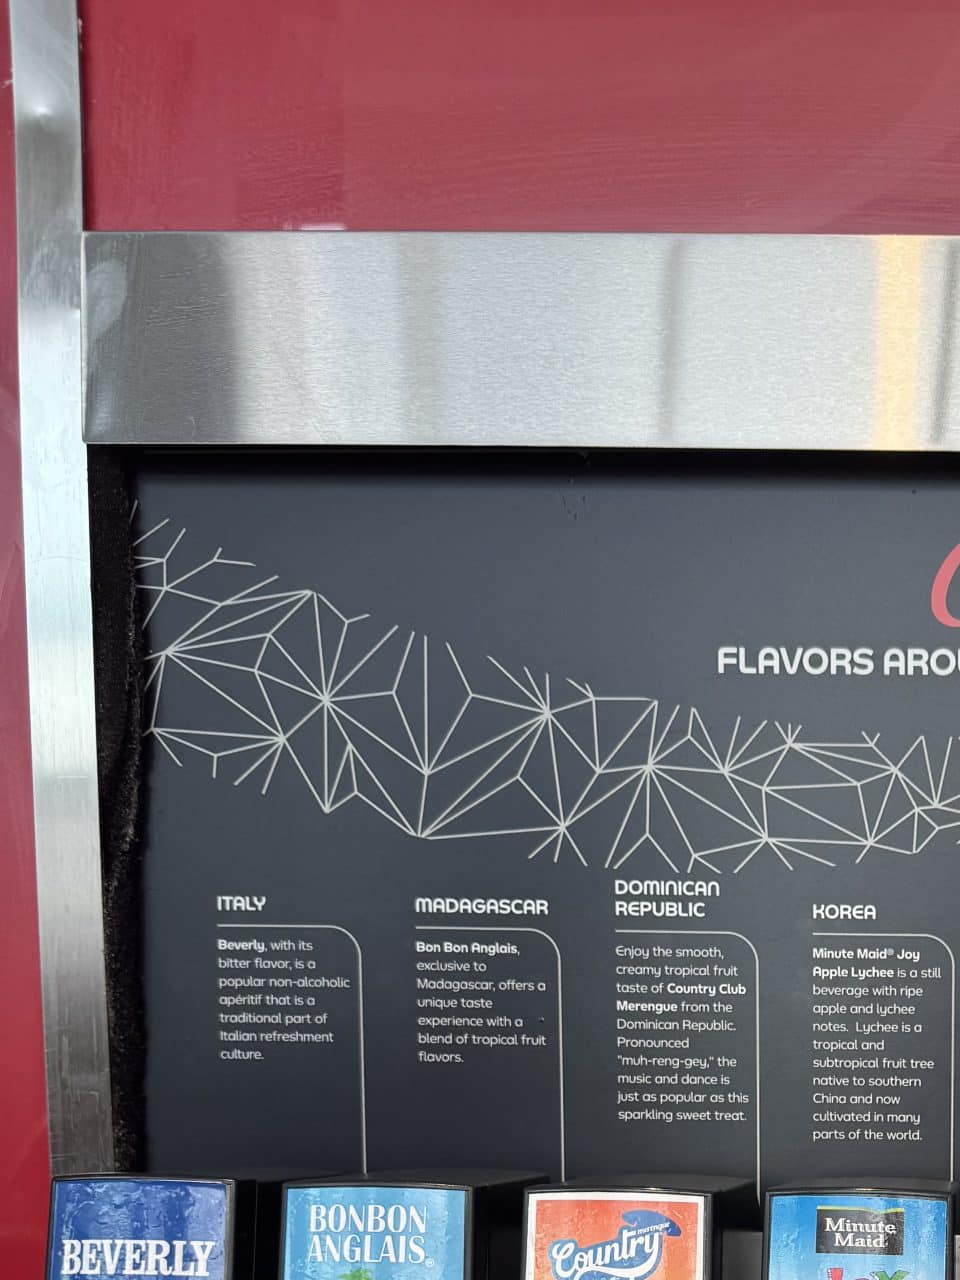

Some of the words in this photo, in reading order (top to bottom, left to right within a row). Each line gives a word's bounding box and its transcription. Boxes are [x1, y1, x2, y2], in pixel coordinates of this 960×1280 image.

[717, 646, 874, 676] FLAVORS
[614, 879, 721, 897] DOMINICAN
[217, 895, 267, 912] ITALY
[414, 897, 549, 916] MADAGASCAR
[615, 900, 706, 918] REPUBLIC
[812, 903, 877, 920] KOREA
[217, 939, 268, 953] Beverly,
[270, 939, 296, 951] with
[298, 940, 313, 951] its
[416, 960, 471, 972] exclusive
[473, 961, 487, 972] to
[616, 966, 661, 978] creamy
[664, 964, 711, 978] tropical
[713, 964, 738, 977] fruit
[218, 976, 267, 989] popular
[268, 976, 350, 988] non-alcoholic
[416, 978, 496, 992] Madagascar,
[498, 979, 535, 991] offers
[537, 982, 546, 991] a
[812, 984, 869, 999] beverage
[872, 984, 897, 996] with
[900, 985, 923, 999] ripe
[417, 996, 458, 1010] unique
[460, 998, 493, 1008] taste
[218, 1012, 283, 1024] traditional
[284, 1013, 312, 1026] part
[314, 1013, 328, 1024] of
[417, 1015, 484, 1029] experience
[486, 1016, 512, 1027] with
[514, 1018, 523, 1027] a
[616, 1018, 680, 1030] Dominican
[682, 1019, 736, 1033] Republic.
[220, 1030, 257, 1042] Italian
[259, 1030, 334, 1043] refreshment
[617, 1036, 689, 1048] Pronounced
[812, 1039, 858, 1052] tropical
[861, 1039, 885, 1051] and
[220, 1048, 264, 1060] culture.
[418, 1050, 464, 1063] flavors.
[617, 1054, 714, 1069] "muh-reng-gey,"
[717, 1056, 737, 1067] the
[813, 1056, 879, 1071] subtropical
[882, 1057, 907, 1069] fruit
[910, 1058, 935, 1069] tree
[813, 1075, 850, 1086] native
[852, 1076, 866, 1086] to
[868, 1075, 922, 1088] southern
[618, 1108, 673, 1123] sparkling
[676, 1110, 712, 1121] sweet
[714, 1110, 747, 1121] treat.
[309, 1204, 427, 1233] BONBON
[824, 1217, 898, 1236] Minute
[833, 1232, 887, 1249] Maid
[307, 1235, 426, 1264] ANGLAIS
[551, 1229, 660, 1279] Country
[61, 1238, 215, 1278] BEVERLY
